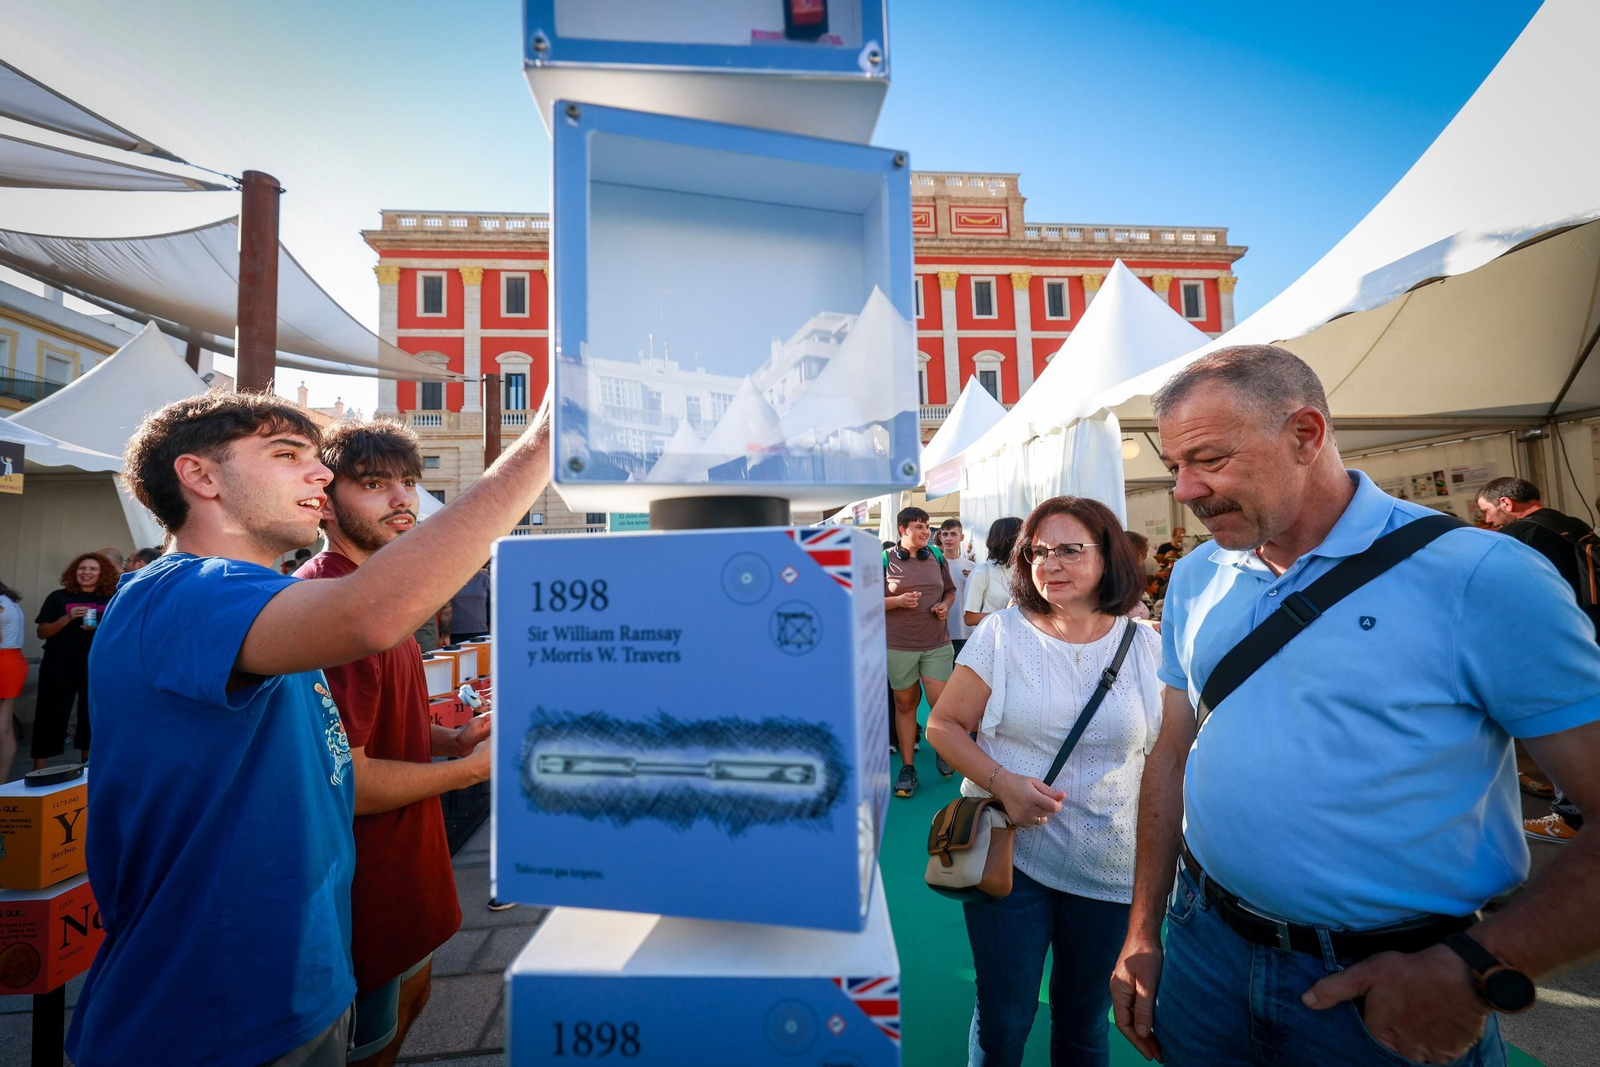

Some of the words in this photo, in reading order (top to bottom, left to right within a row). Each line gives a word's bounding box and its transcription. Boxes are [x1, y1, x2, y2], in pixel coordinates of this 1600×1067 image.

[531, 579, 609, 612] 1898
[1362, 617, 1371, 627] A
[528, 626, 548, 642] Sir
[552, 625, 615, 642] William
[620, 626, 682, 647] Ramsay
[528, 651, 535, 667] y
[541, 647, 593, 664] Morris
[597, 647, 617, 663] W.
[624, 647, 681, 664] Travers
[51, 846, 77, 860] Iterbio
[57, 944, 85, 963] Nobelio
[552, 1020, 642, 1058] 1898
